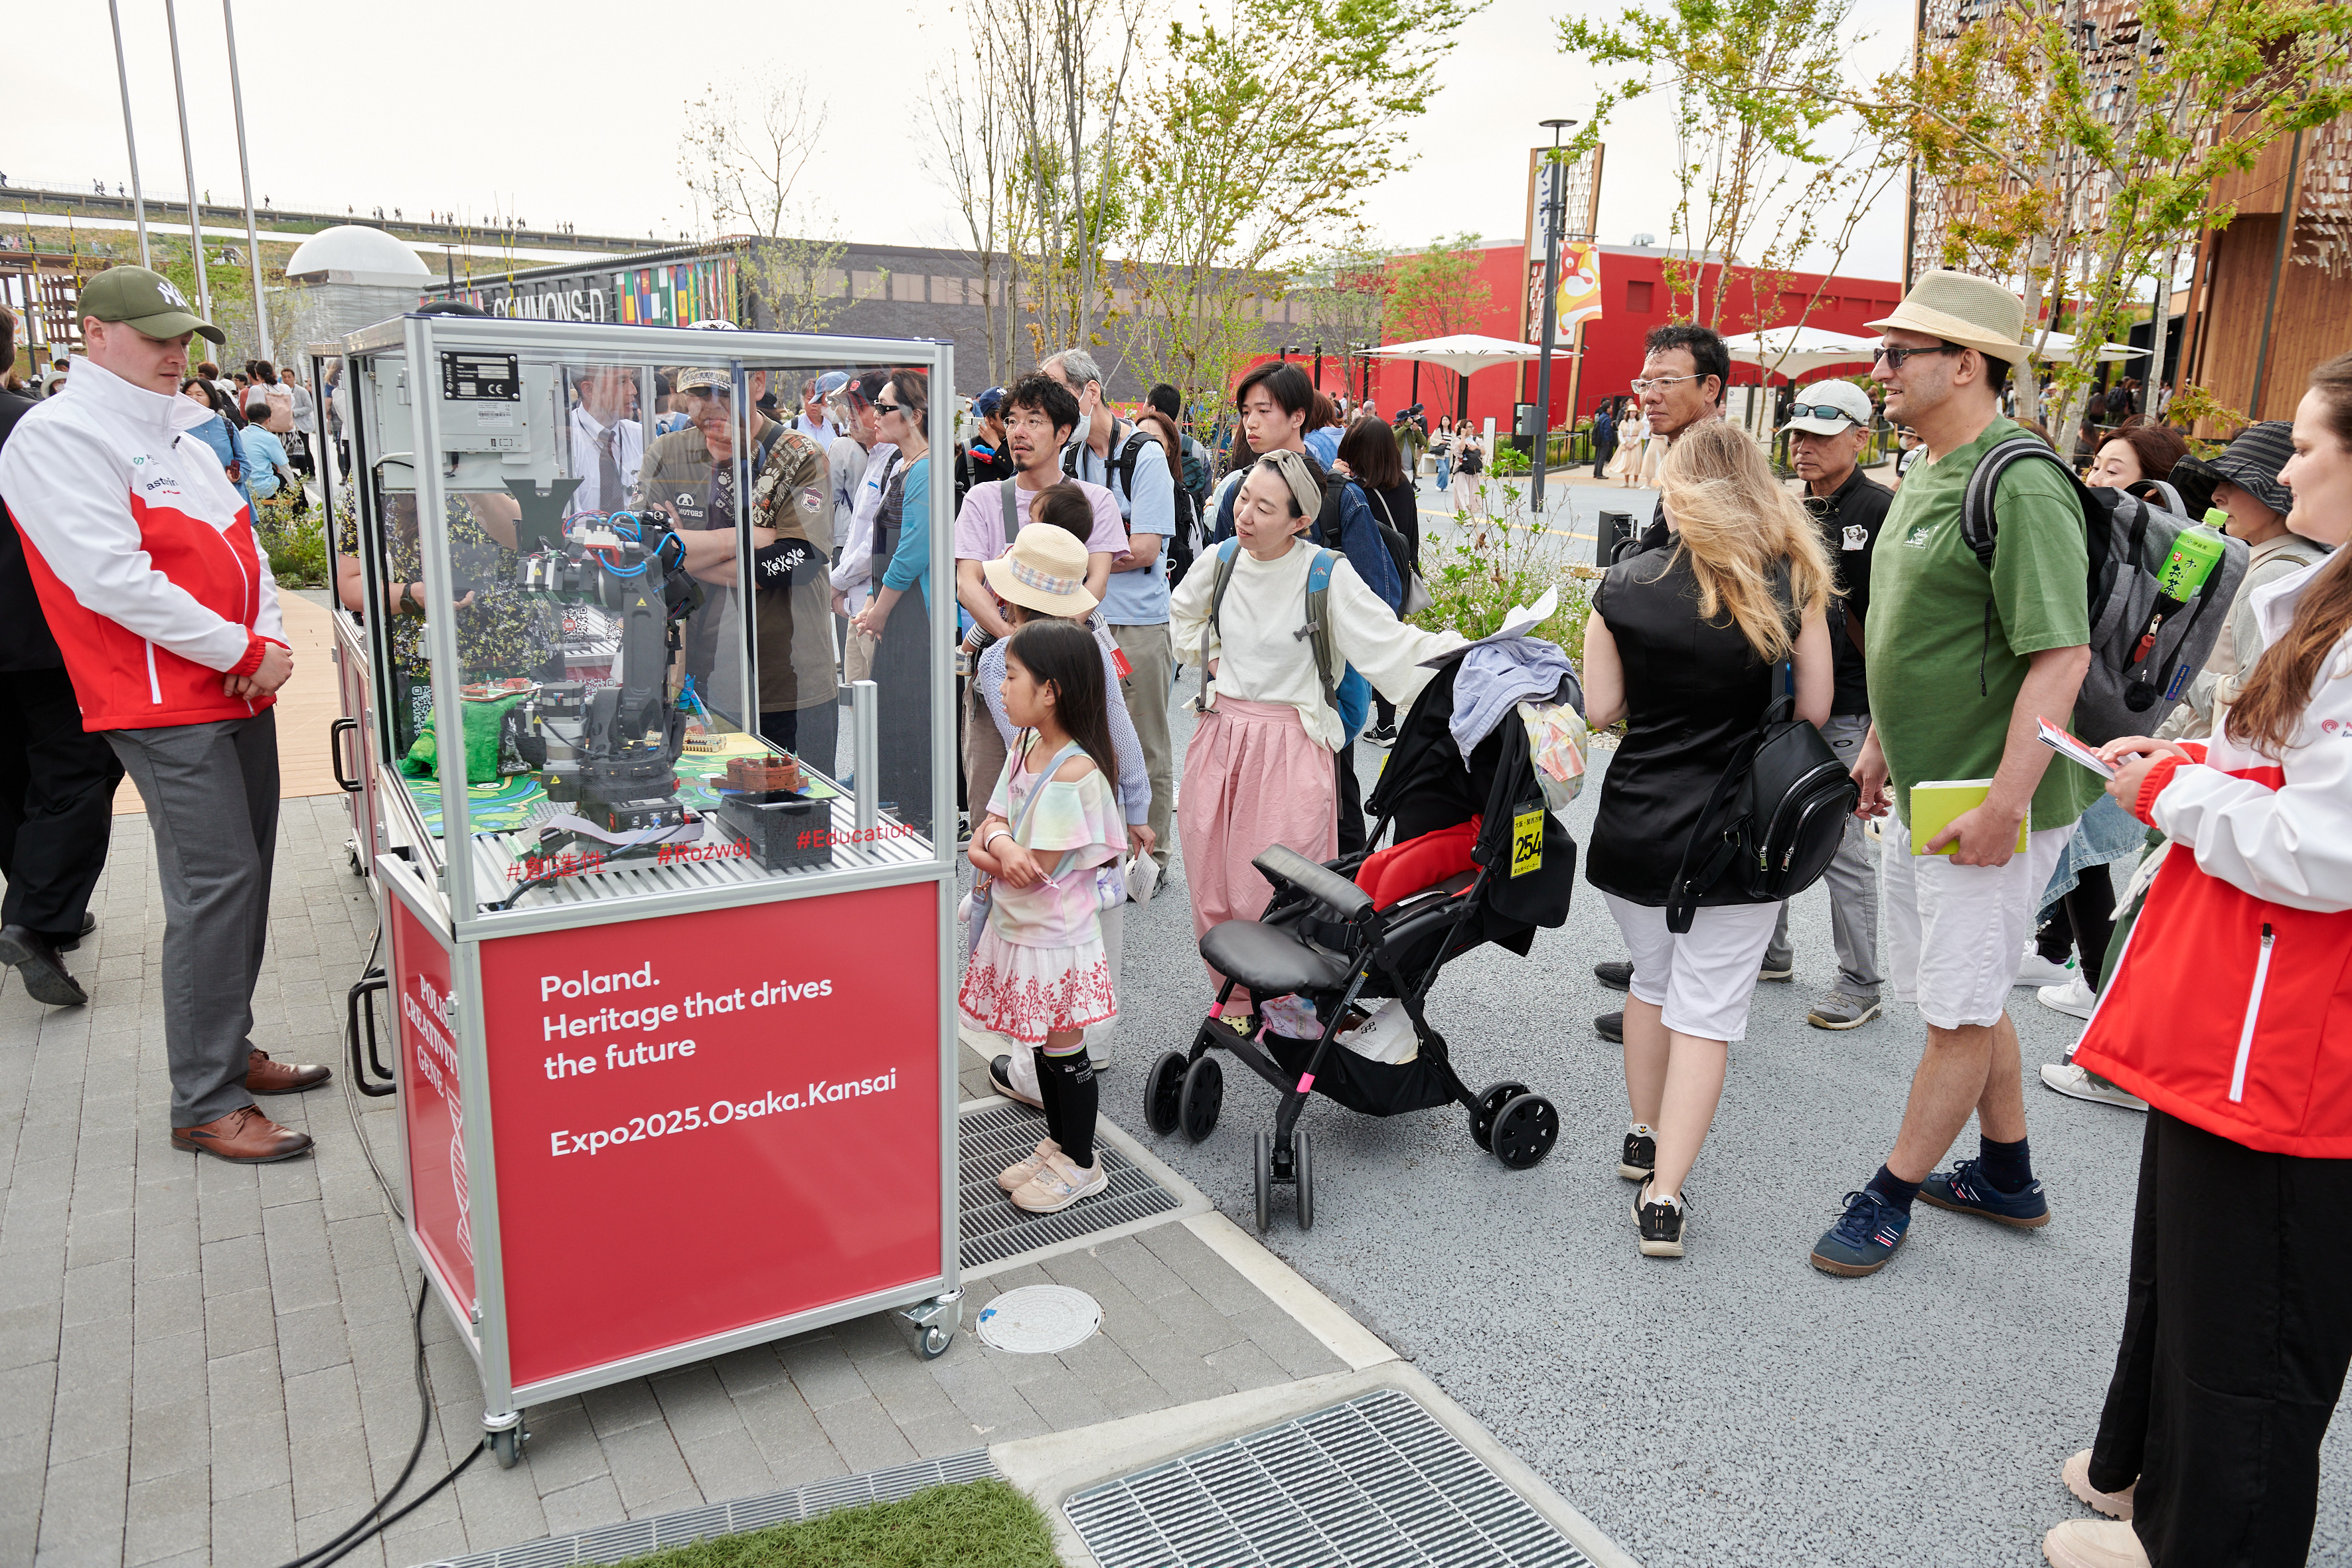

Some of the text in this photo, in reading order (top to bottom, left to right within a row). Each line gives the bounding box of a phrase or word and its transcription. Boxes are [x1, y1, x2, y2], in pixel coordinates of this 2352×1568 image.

[157, 281, 187, 307] NY
[494, 288, 605, 323] COMMONS-D
[678, 508, 704, 517] MOTORS
[2164, 564, 2181, 595] お茶
[657, 838, 751, 866] #Rozwój
[797, 823, 914, 850] #Education
[1515, 831, 1542, 864] 254
[507, 850, 606, 882] #創造性
[540, 961, 661, 1002] Poland.
[419, 973, 456, 1039] POLIS
[543, 979, 833, 1041] Heritage that drives
[417, 1045, 444, 1098] GENE
[544, 1038, 696, 1080] the future
[550, 1067, 897, 1156] Expo2025.Osaka.Kansai
